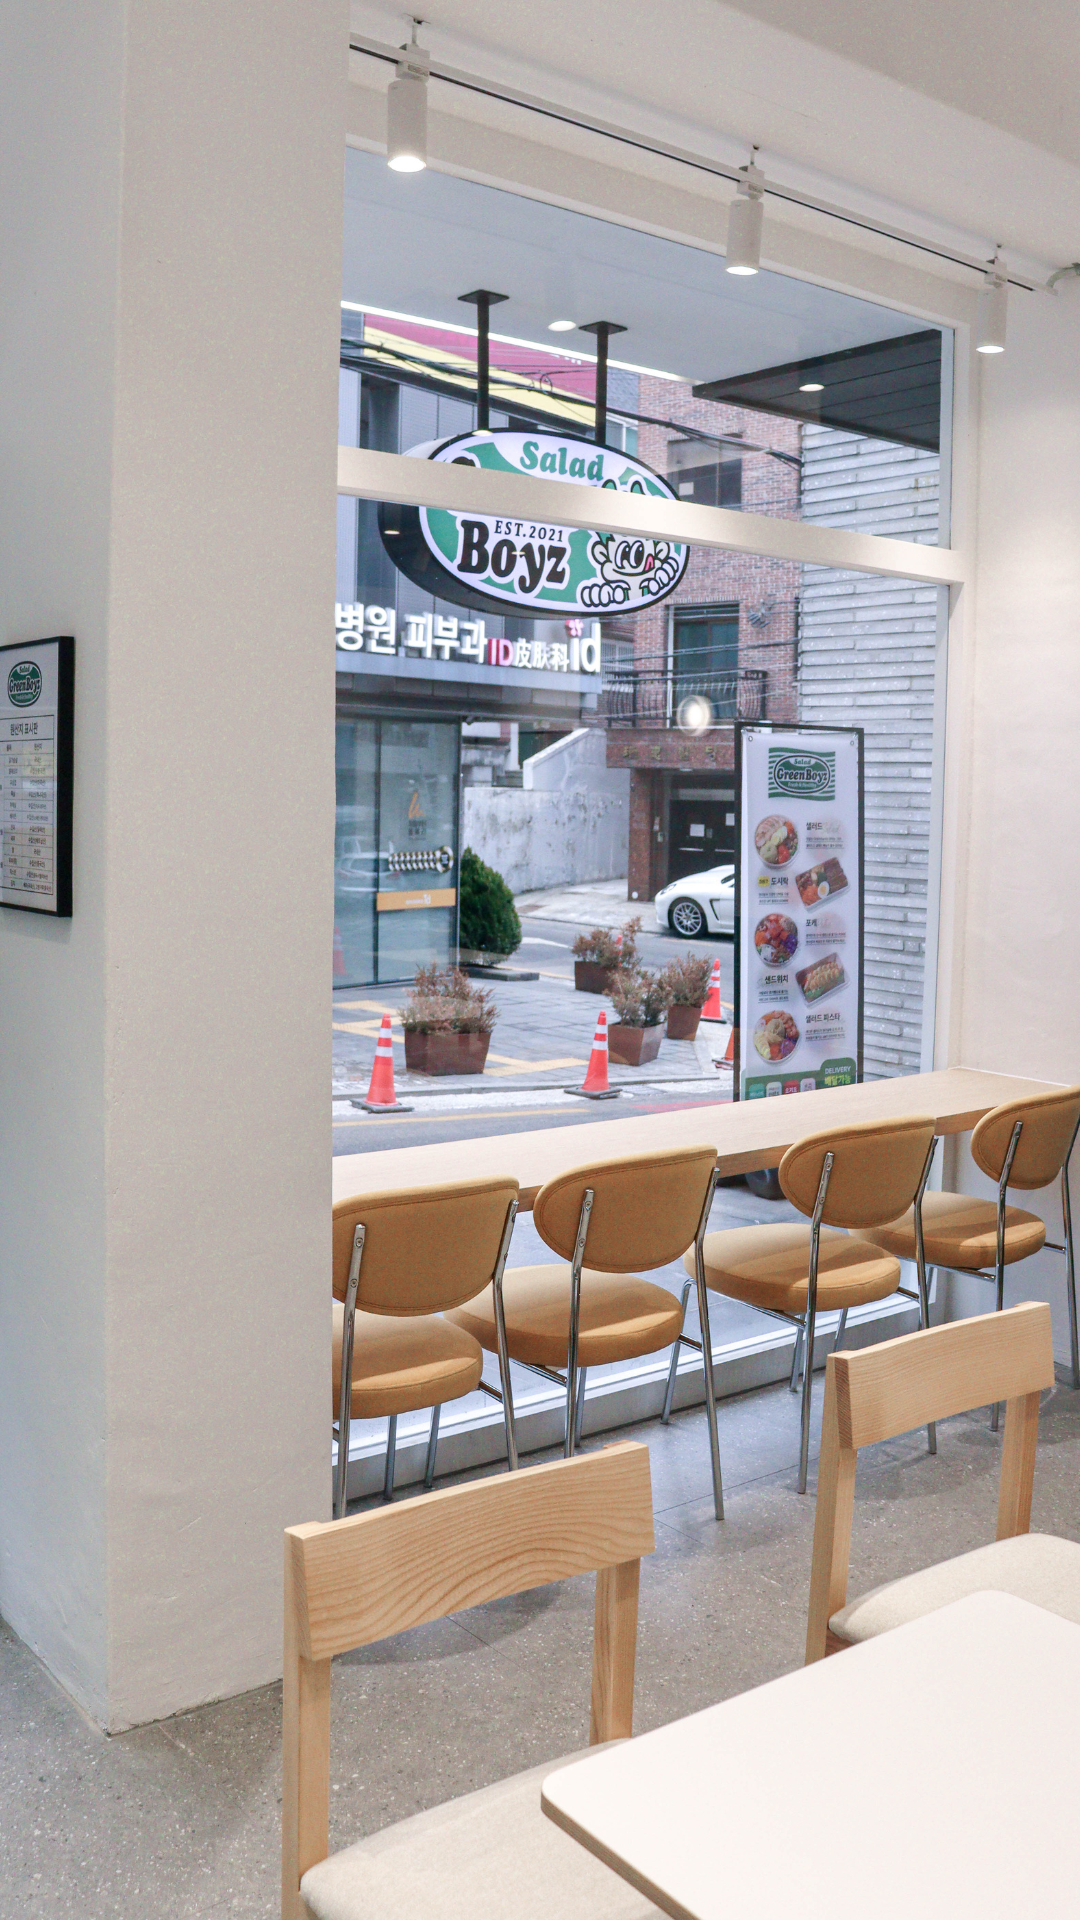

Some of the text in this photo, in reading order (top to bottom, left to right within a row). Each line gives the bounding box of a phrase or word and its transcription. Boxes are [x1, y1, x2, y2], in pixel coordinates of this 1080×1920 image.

[519, 441, 604, 481] Salad
[494, 519, 564, 543] EST.2021
[457, 519, 570, 594] Boyz
[335, 602, 396, 655] 병원
[403, 611, 488, 664] 피부과
[10, 722, 39, 736] 원산지 표시판
[776, 767, 828, 784] GreenBoyz
[770, 877, 789, 886] 도시락
[823, 1012, 841, 1022] 파스타
[824, 1065, 852, 1075] DELIVERY
